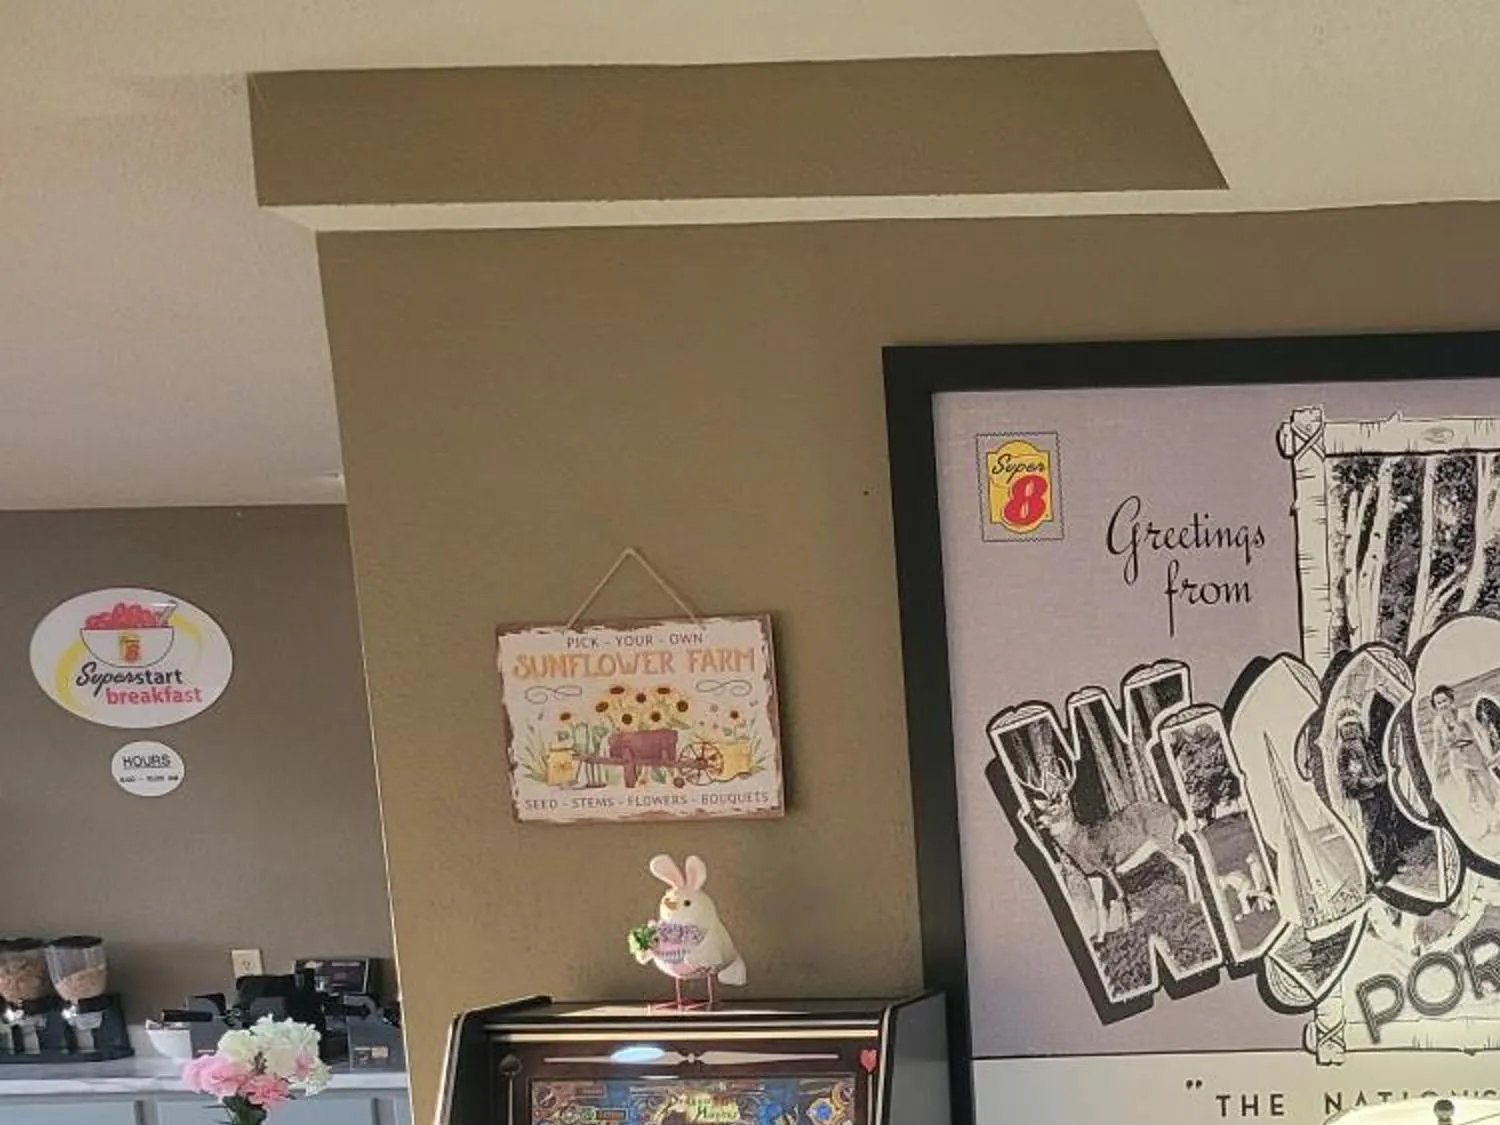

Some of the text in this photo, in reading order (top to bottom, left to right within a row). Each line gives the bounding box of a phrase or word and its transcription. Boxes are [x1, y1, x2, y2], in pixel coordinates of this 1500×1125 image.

[992, 453, 1046, 484] Super
[1002, 474, 1048, 526] 8
[1106, 495, 1266, 585] Greetings
[1165, 559, 1253, 638] from
[566, 635, 599, 649] PICK
[615, 634, 654, 648] YOUR
[669, 633, 703, 645] OWN
[76, 661, 183, 697] Superstart
[513, 647, 755, 680] SUNFLOWER FARM
[105, 685, 203, 705] breakfast
[122, 753, 171, 769] HOURS
[571, 797, 615, 810] STEMS
[627, 795, 687, 808] FLOWERS
